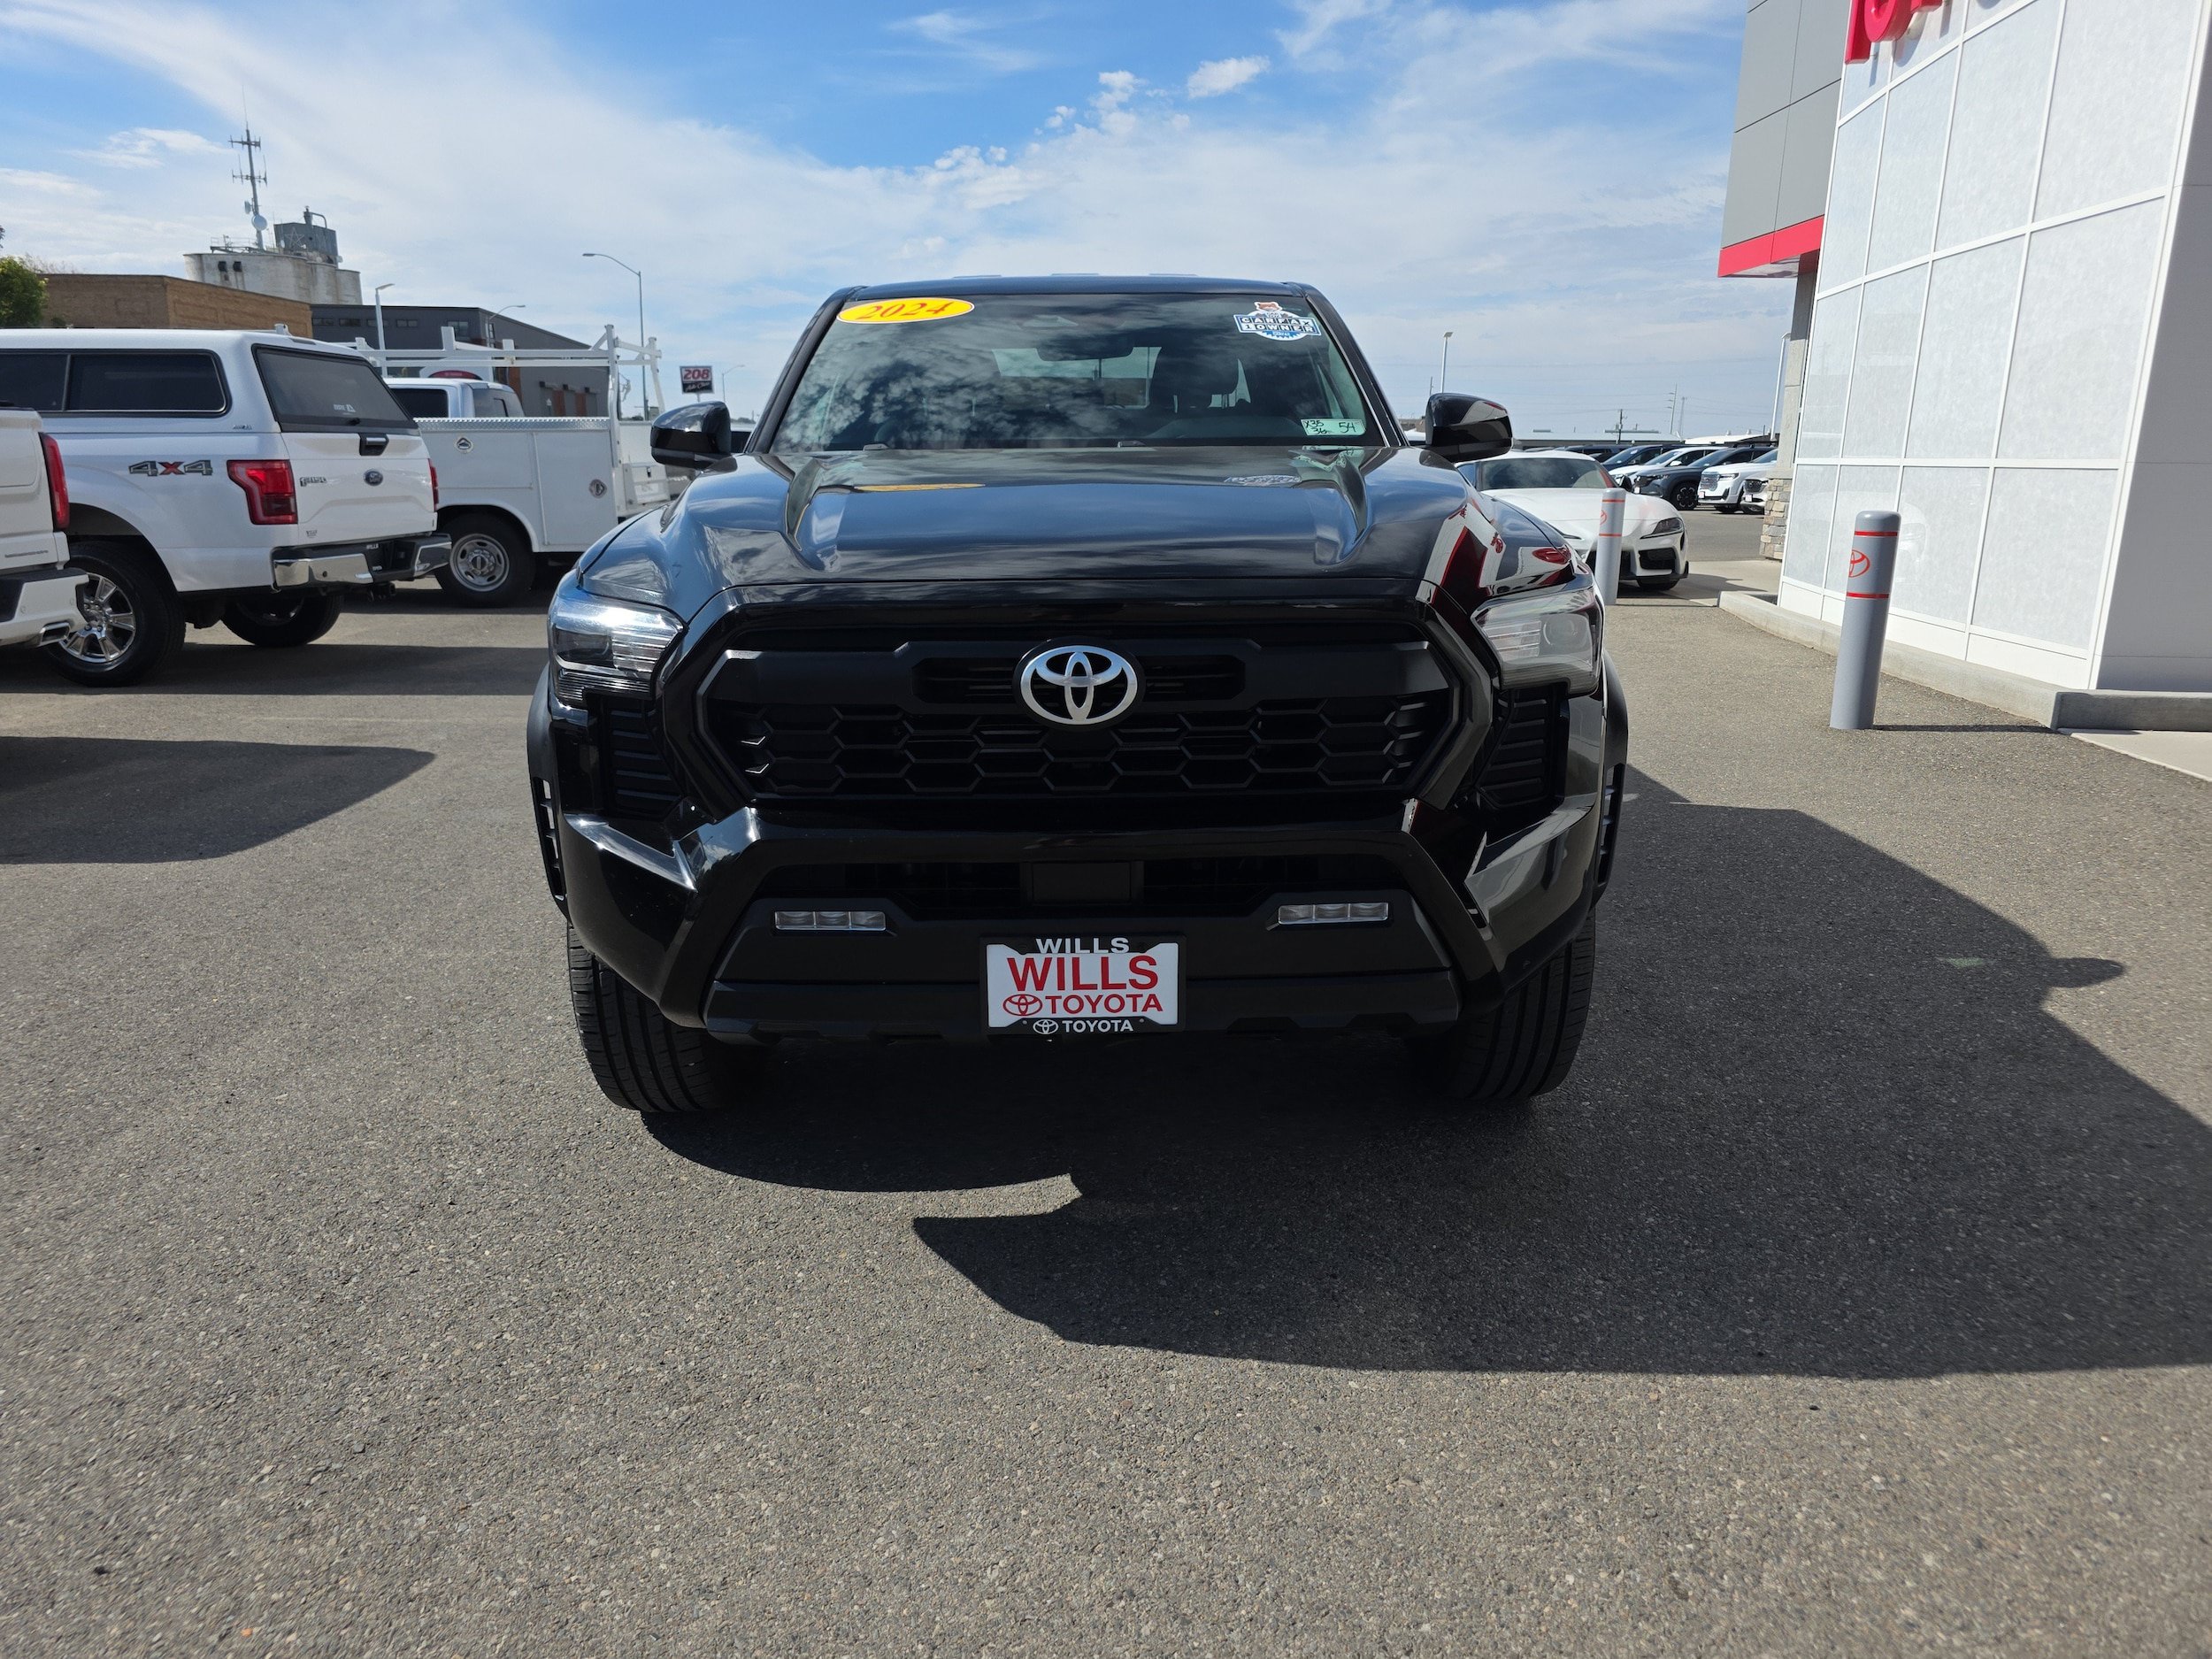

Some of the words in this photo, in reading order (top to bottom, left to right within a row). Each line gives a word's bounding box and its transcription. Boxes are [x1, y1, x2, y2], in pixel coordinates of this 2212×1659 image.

[855, 302, 955, 319] 2024
[1256, 324, 1314, 333] OWNER
[684, 369, 710, 380] 208
[1035, 937, 1130, 955] WILLS
[1007, 955, 1159, 992] WILLS
[1045, 993, 1164, 1015] TOYOTA
[1062, 1018, 1134, 1033] TOYOTA
